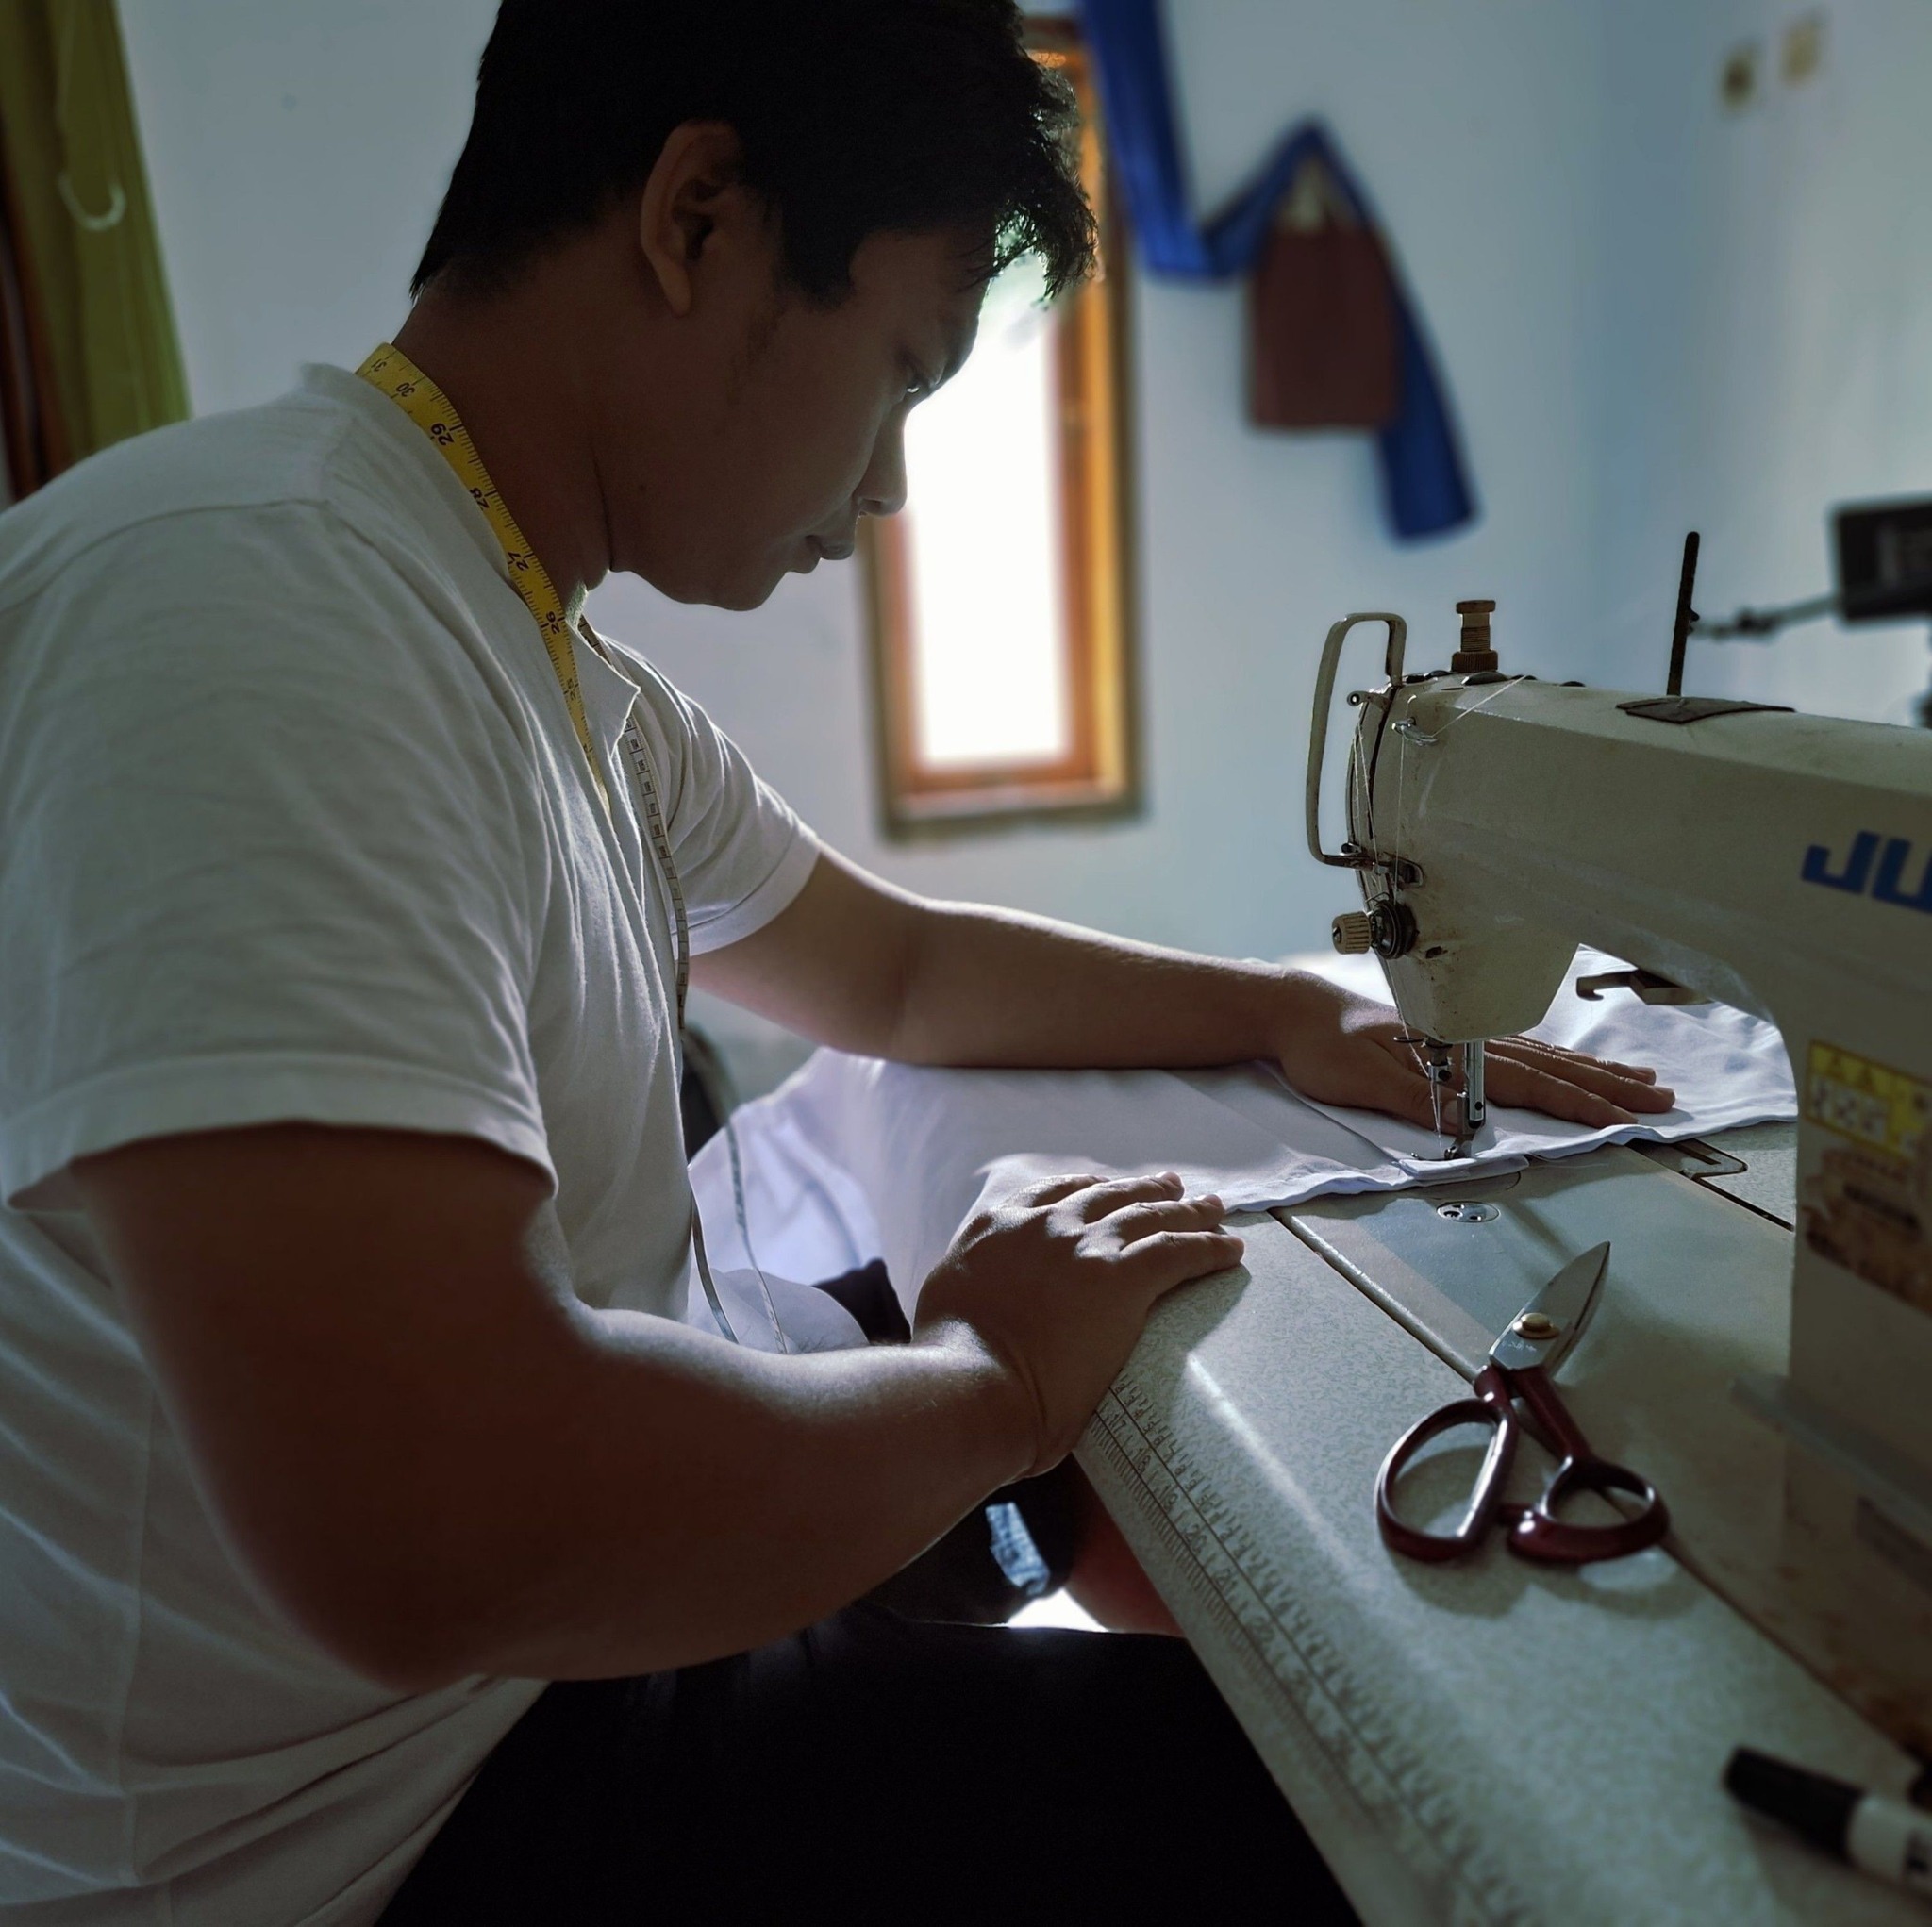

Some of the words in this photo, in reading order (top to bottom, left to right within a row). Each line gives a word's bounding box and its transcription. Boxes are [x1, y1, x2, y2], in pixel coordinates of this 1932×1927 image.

[396, 382, 416, 397] 30
[430, 423, 455, 446] 29
[470, 487, 490, 509] 28
[507, 550, 530, 572] 27
[546, 611, 560, 635] 26
